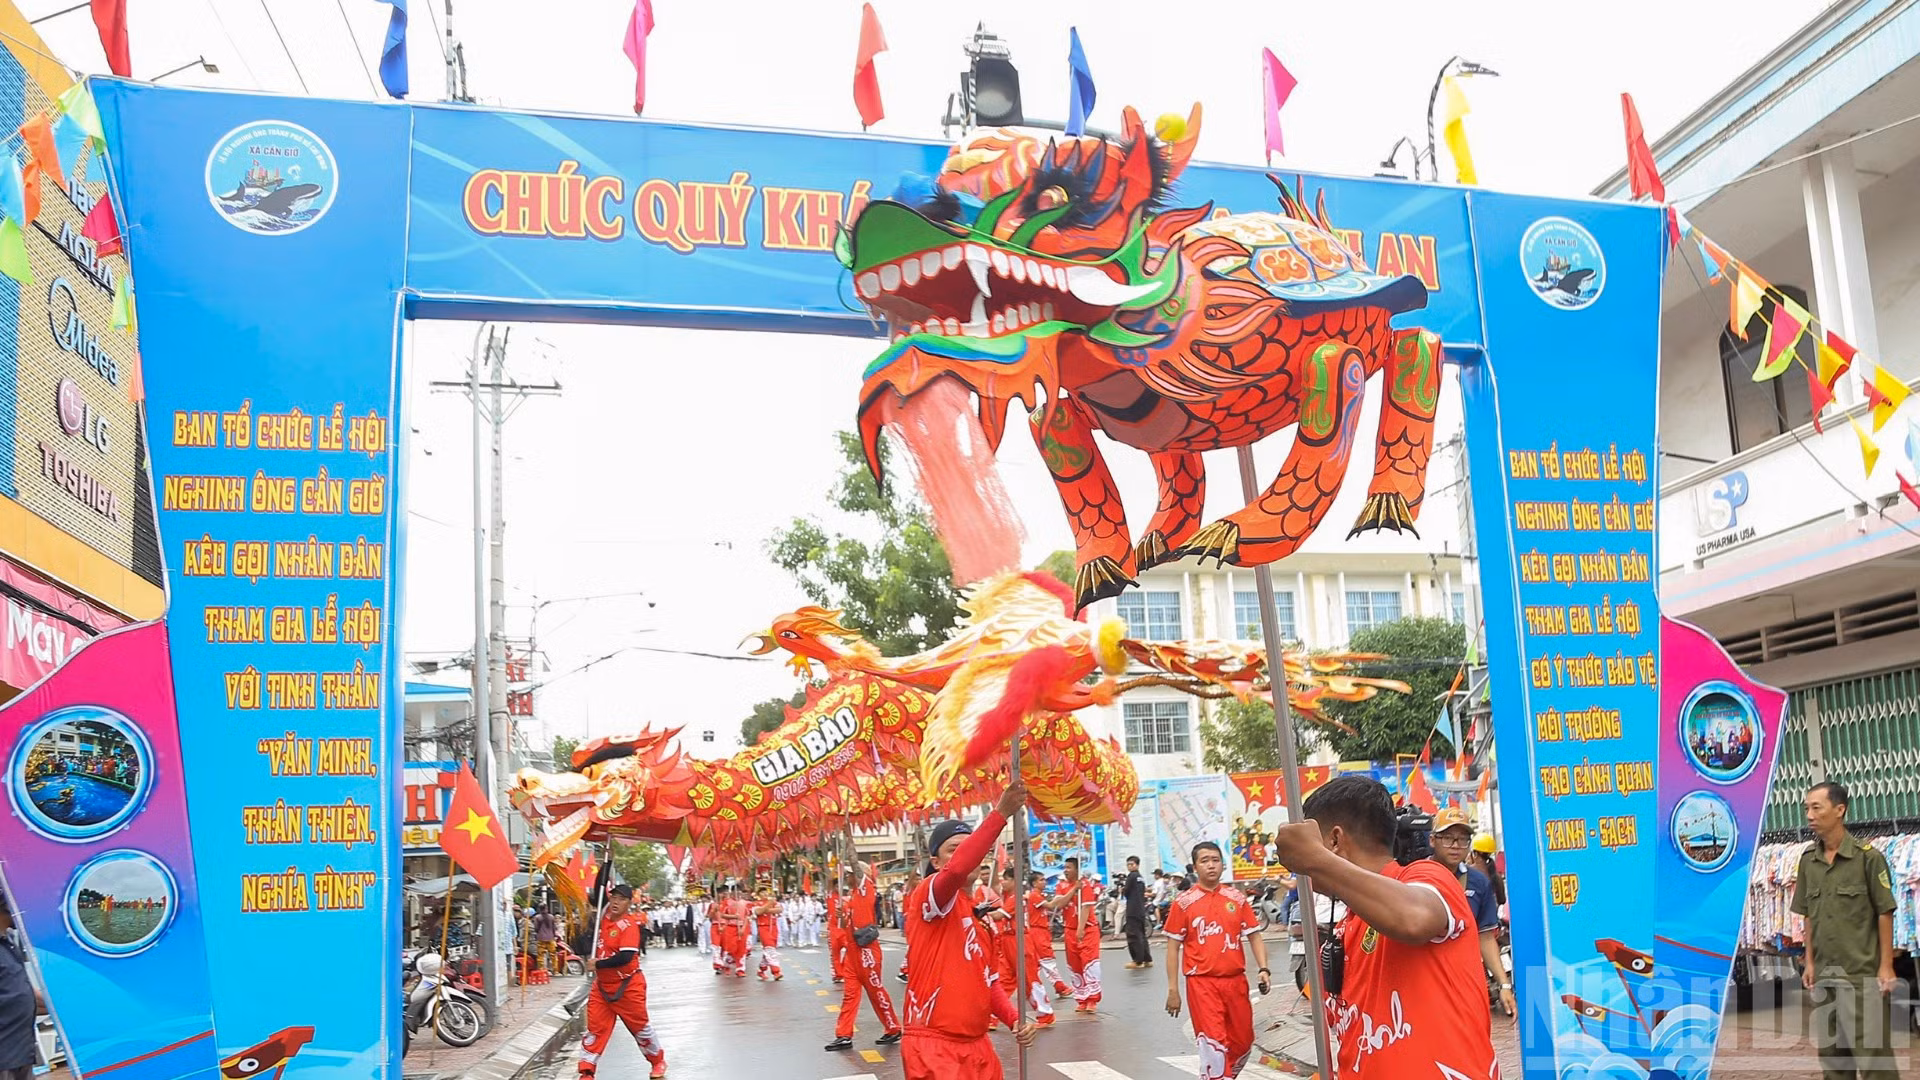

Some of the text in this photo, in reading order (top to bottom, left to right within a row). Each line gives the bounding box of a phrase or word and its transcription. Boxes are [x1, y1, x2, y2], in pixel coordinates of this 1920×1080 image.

[463, 160, 624, 239] CHÚC
[633, 171, 757, 256] QUÝ
[1375, 232, 1440, 291] AN
[61, 308, 120, 386] Midea
[82, 402, 112, 455] LG
[172, 398, 387, 460] BAN TỔ CHỨC LỄ HỘI
[38, 440, 121, 524] TOSHIBA
[1509, 439, 1649, 488] BAN TỔ CHỨC LỄ HỘI
[163, 464, 386, 515] NGHINH ÔNG CẦN GIỜ
[1514, 501, 1570, 531] NGHINH
[1571, 495, 1602, 532] ÔNG
[1603, 491, 1633, 532] CẦN
[183, 533, 383, 586] KÊU GỌI NHÂN DÂN
[1696, 525, 1757, 557] US PHARMA USA
[1520, 547, 1650, 589] KÊU GỌI NHÂN DÂN
[204, 592, 382, 652] THAM GIA LỄ HỘI
[1525, 593, 1642, 640] THAM GIA LỄ HỘI
[224, 659, 380, 710] VỚI TINH THẦN
[1531, 648, 1658, 692] CÓ Ý THỨC BẢO VỆ
[751, 705, 858, 786] GIA BẢO
[1536, 703, 1623, 744] MÔI TRƯỜNG
[257, 730, 378, 779] “VĂN MINH,
[1540, 755, 1655, 803] TẠO CẢNH QUAN
[243, 797, 377, 851] THÂN THIỆN,
[1545, 818, 1588, 852] XANH
[1598, 814, 1638, 854] SẠCH
[241, 864, 376, 913] NGHĨA TÌNH”
[1550, 873, 1580, 913] ĐẸP
